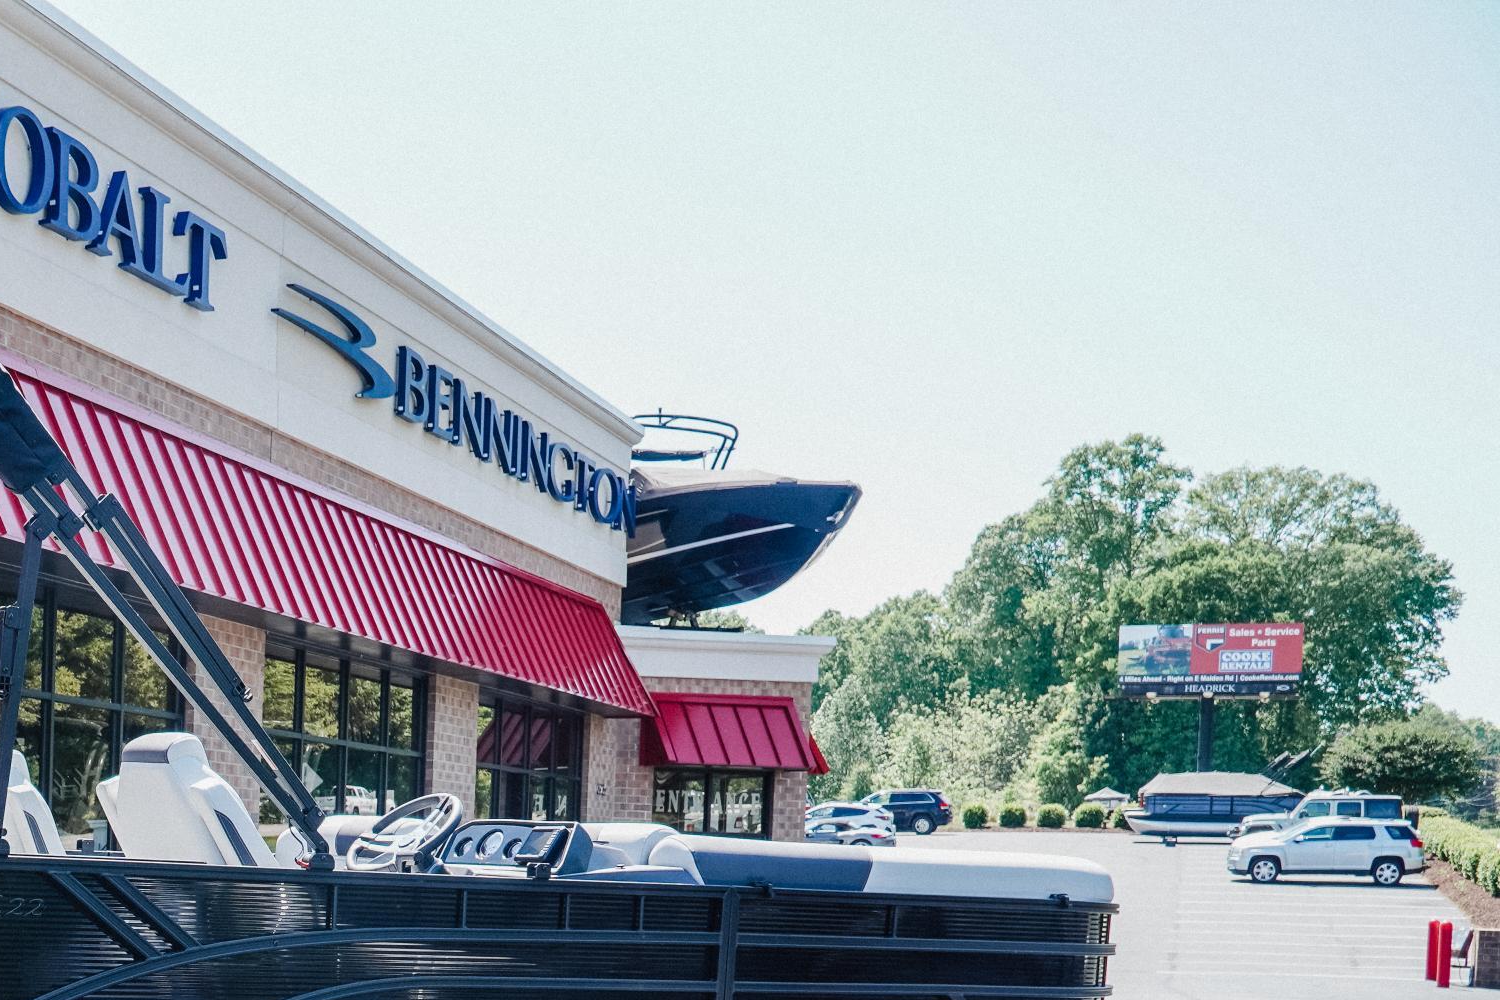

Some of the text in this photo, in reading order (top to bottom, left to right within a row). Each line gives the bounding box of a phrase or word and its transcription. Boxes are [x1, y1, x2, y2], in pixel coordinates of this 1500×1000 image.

[394, 344, 636, 539] BENNINGTON
[1229, 627, 1300, 637] Sales Service
[1251, 639, 1276, 647] Parts
[1222, 651, 1271, 662] COOKE
[1220, 661, 1270, 670] RENTALS
[1167, 675, 1184, 683] Right
[1184, 684, 1235, 693] HEADRICK
